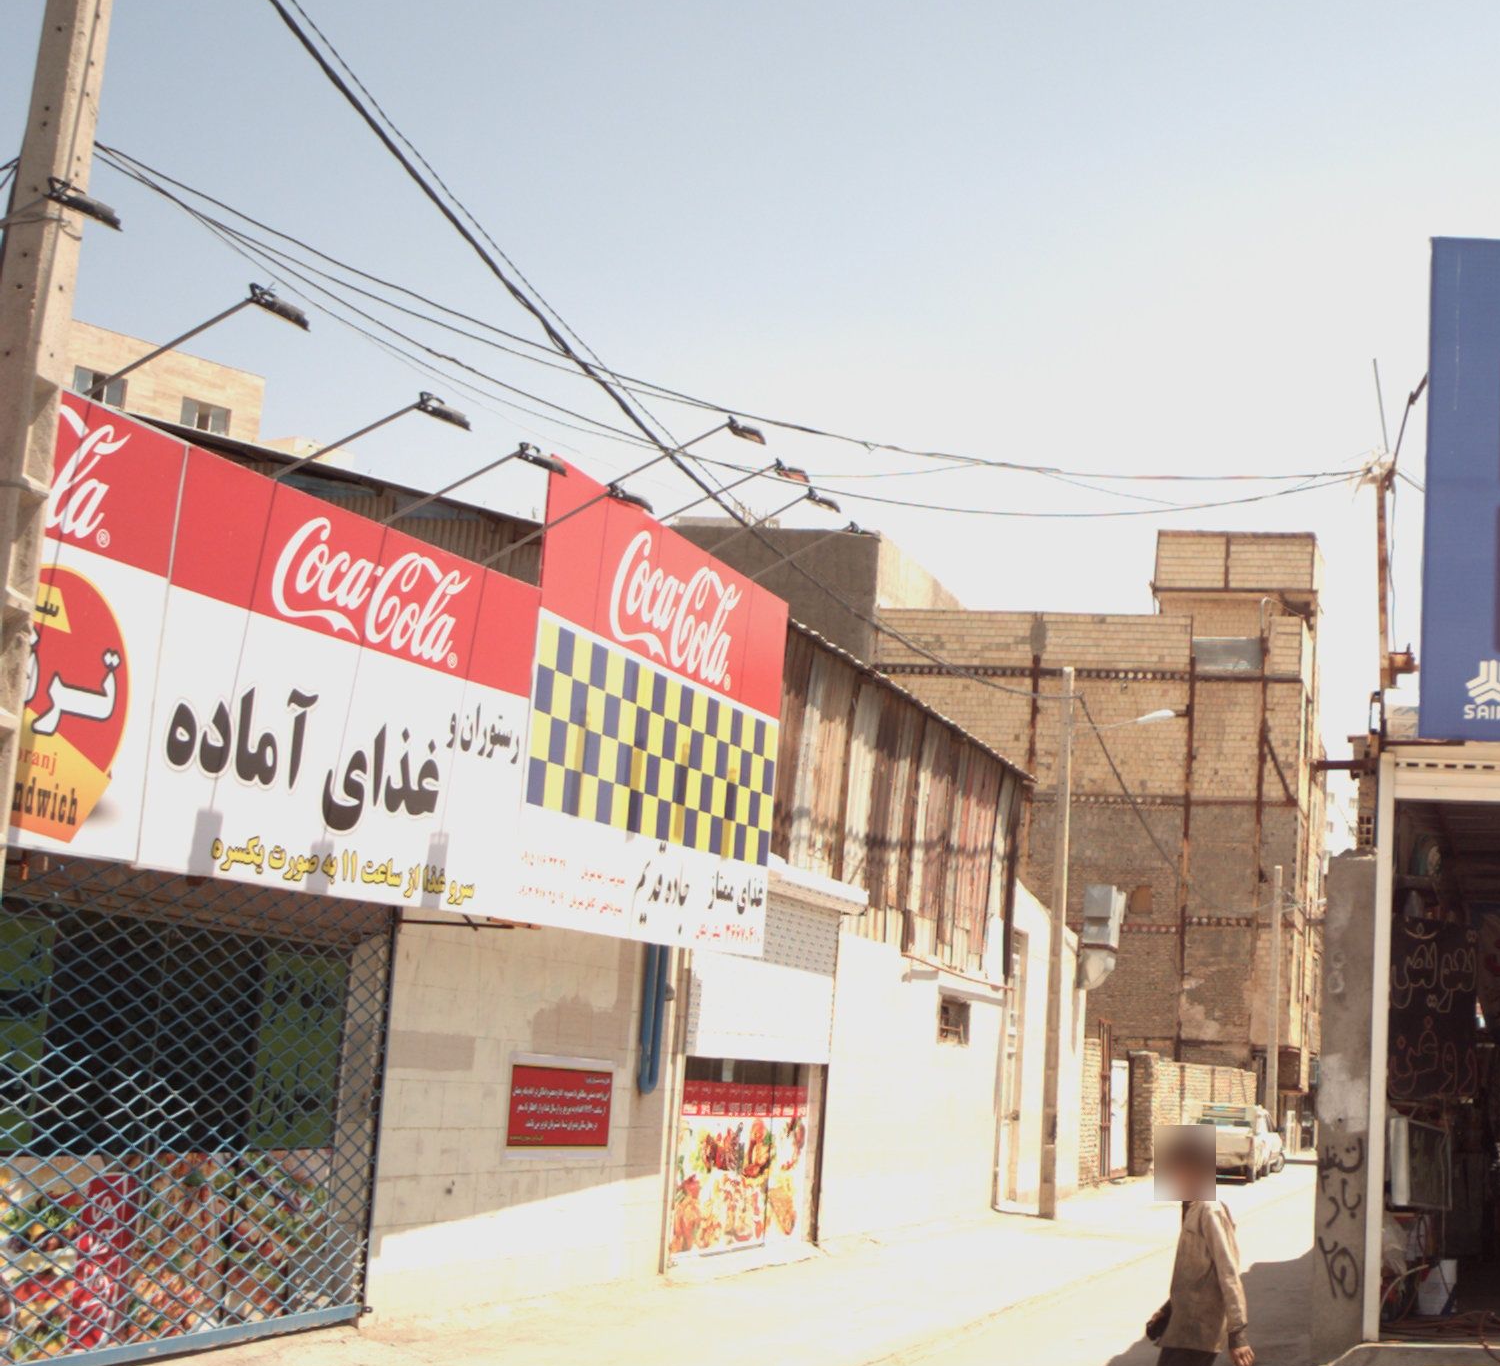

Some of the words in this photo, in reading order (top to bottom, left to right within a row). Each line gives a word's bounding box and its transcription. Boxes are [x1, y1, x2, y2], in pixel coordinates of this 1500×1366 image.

[271, 516, 471, 664] Coca-Cola
[610, 531, 742, 687] Coca-Cola
[165, 686, 319, 789] آماده
[446, 711, 458, 748] و
[458, 703, 520, 765] رستوران
[17, 747, 57, 776] oranj
[322, 723, 442, 834] غذای
[13, 776, 78, 825] ndwich
[211, 835, 265, 874] یکسره
[268, 845, 319, 881] صورت
[321, 853, 338, 884] به
[342, 849, 357, 883] ۱۱
[361, 857, 403, 887] ساعت
[404, 863, 421, 898] از
[422, 864, 446, 894] غذا
[448, 880, 475, 906] سرو
[1390, 1015, 1477, 1096] روغن
